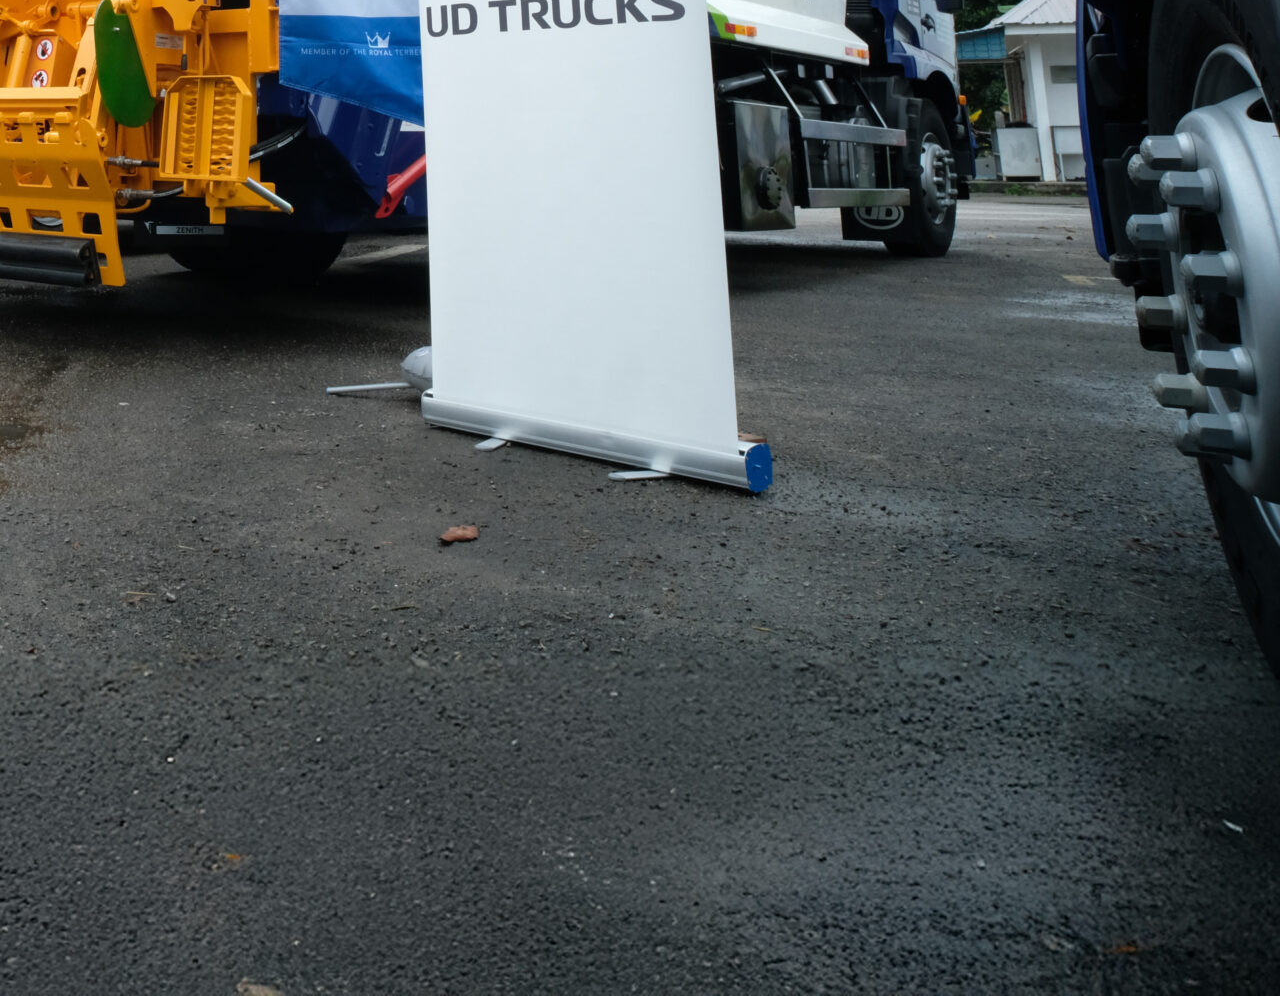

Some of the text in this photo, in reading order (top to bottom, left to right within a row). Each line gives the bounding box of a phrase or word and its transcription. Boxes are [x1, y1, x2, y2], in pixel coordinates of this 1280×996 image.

[426, 2, 478, 38] UD
[300, 47, 337, 56] MEMBER
[353, 48, 367, 56] THE
[368, 48, 393, 57] ROYAL
[394, 49, 422, 57] TERBE
[175, 226, 204, 234] ZENITH
